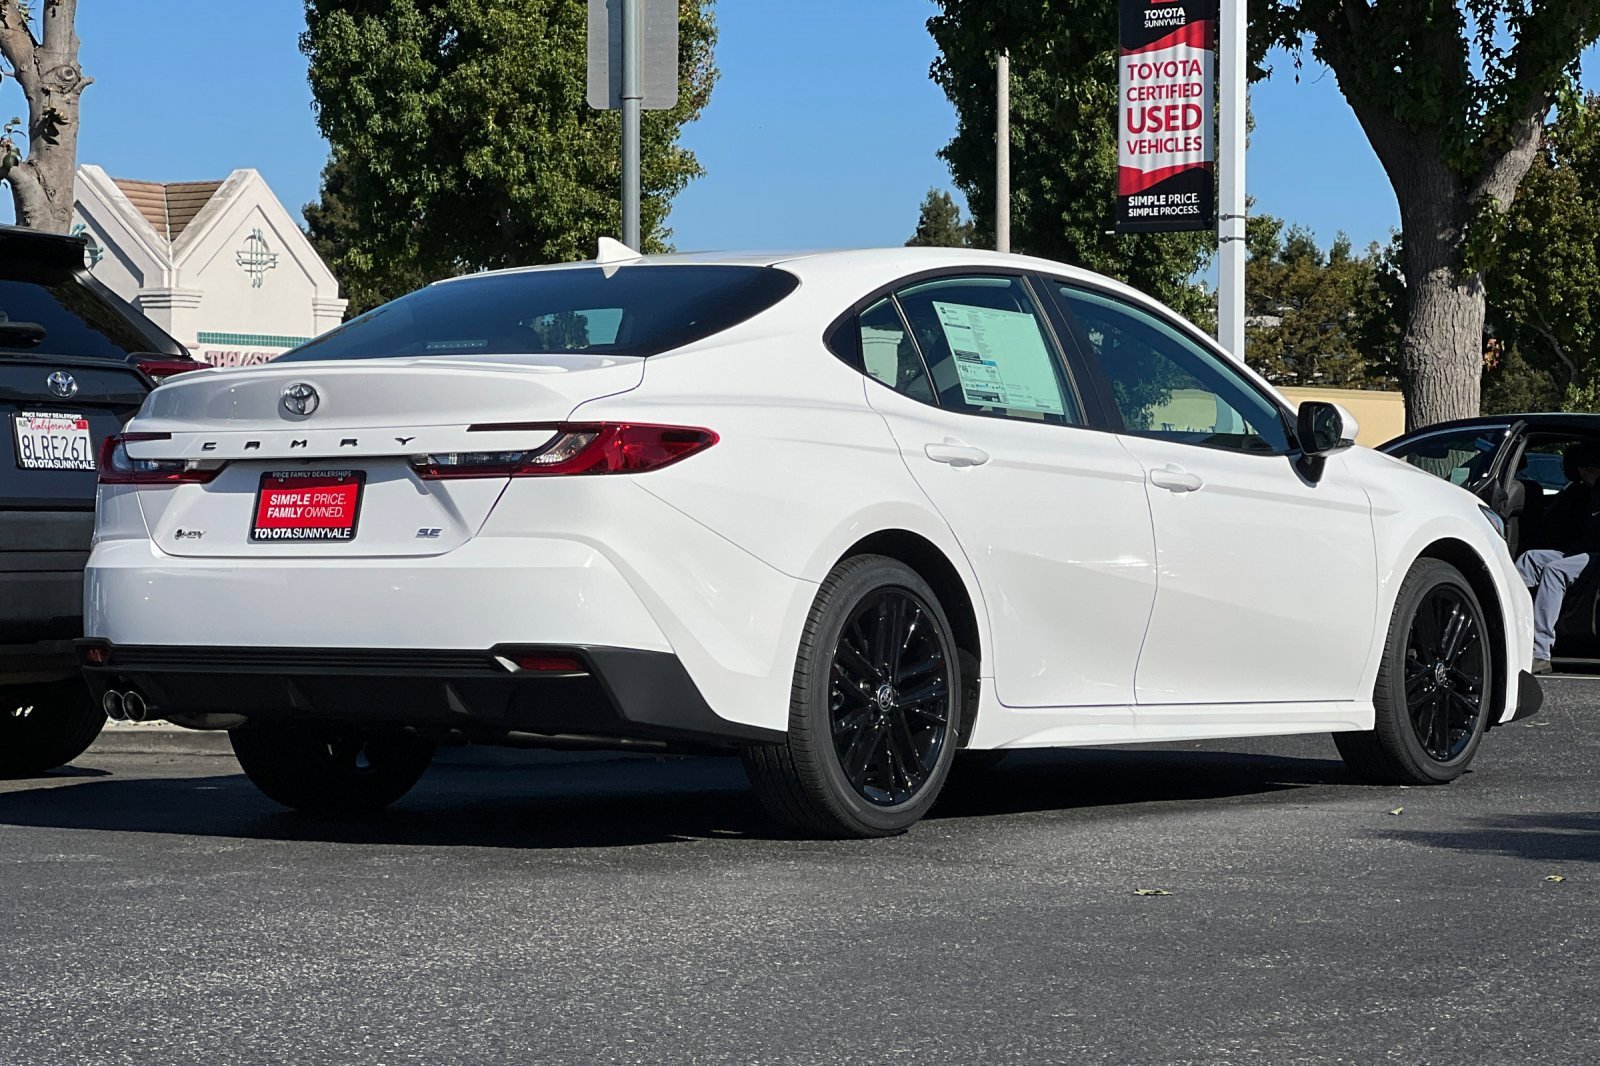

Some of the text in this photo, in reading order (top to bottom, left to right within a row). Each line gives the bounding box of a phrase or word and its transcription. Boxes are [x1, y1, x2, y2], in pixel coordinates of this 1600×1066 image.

[1144, 7, 1185, 20] TOYOTA
[1144, 17, 1186, 28] SUNNYVALE
[1127, 59, 1202, 81] TOYOTA
[1126, 82, 1203, 102] CERTIFIED
[1126, 103, 1203, 134] USED
[1127, 135, 1202, 155] VEHICLES
[1128, 193, 1200, 207] SIMPLE PRICE.
[1128, 205, 1200, 217] SIMPLE PROCESS.
[30, 417, 77, 434] California
[22, 435, 87, 461] 8LRE267
[201, 436, 416, 451] CAMRY
[270, 493, 347, 505] SIMPLE PRICE.
[267, 506, 344, 518] FAMILY OWNED.
[417, 528, 442, 538] SE
